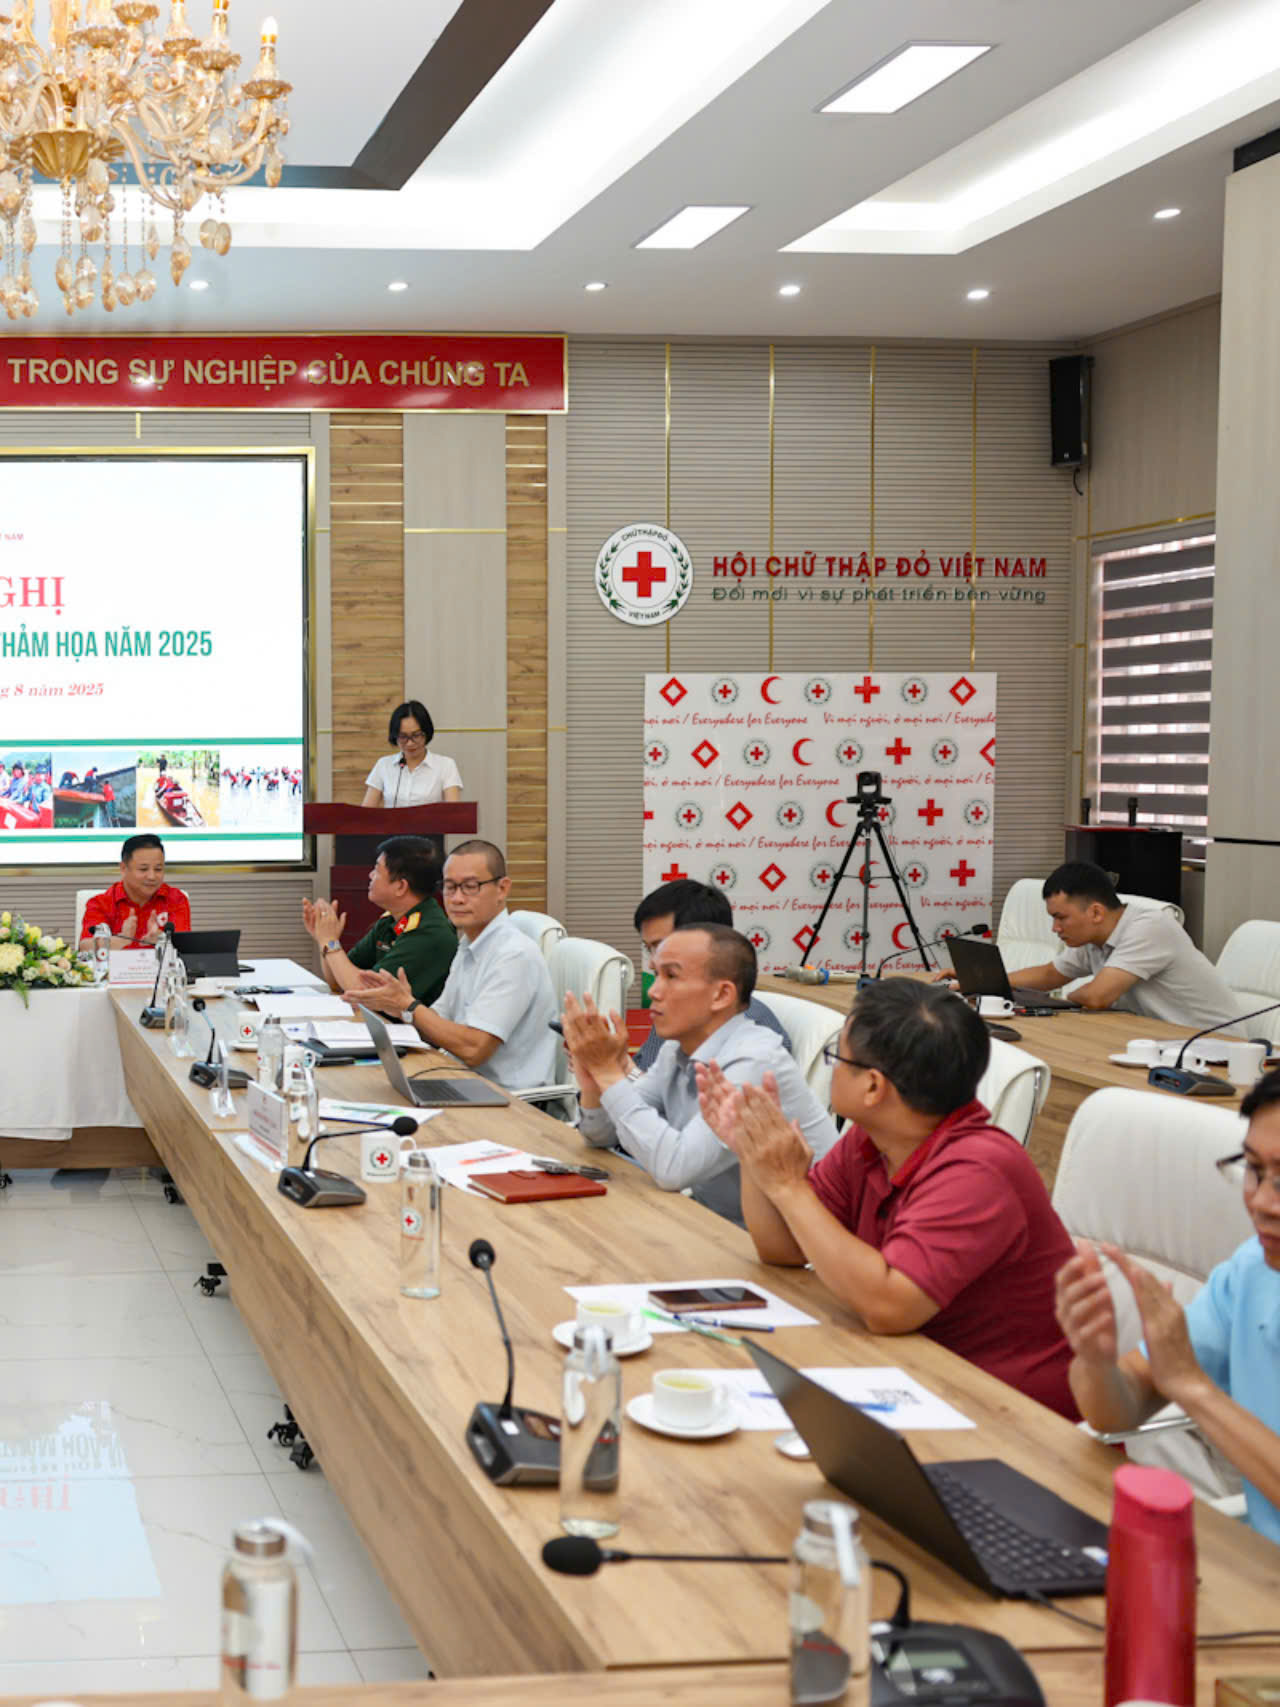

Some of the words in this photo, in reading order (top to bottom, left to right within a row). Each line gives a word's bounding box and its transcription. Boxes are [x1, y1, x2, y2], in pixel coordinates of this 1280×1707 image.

[7, 359, 119, 385] TRONG
[128, 359, 174, 391] SỰ
[184, 354, 297, 391] NGHIỆP
[305, 351, 371, 385] CỦA
[379, 352, 485, 387] CHÚNG
[493, 361, 530, 387] TA
[713, 551, 756, 584] HỘI
[765, 550, 817, 577] CHỮ
[825, 551, 887, 583] THẬP
[896, 549, 931, 577] ĐỎ
[939, 552, 985, 583] VIỆT
[995, 557, 1047, 577] NAM
[712, 582, 745, 601] Đổi
[753, 586, 787, 601] mới
[798, 587, 813, 601] vì
[821, 587, 845, 605] sự
[852, 587, 894, 605] phát
[902, 584, 947, 601] triển
[999, 586, 1047, 605] vững
[56, 630, 99, 663] HỌA
[104, 625, 152, 657] NĂM
[158, 630, 213, 657] 2025
[13, 683, 24, 697] 8
[28, 683, 63, 697] năm
[67, 682, 105, 696] 2025
[691, 712, 744, 728] Everywhere
[747, 712, 762, 728] for
[764, 712, 808, 728] Everyone
[724, 774, 776, 790] Everywhere
[779, 774, 794, 790] for
[796, 773, 840, 790] Everyone
[757, 836, 809, 852] Everywhere
[812, 836, 827, 851] for
[846, 898, 861, 913] for
